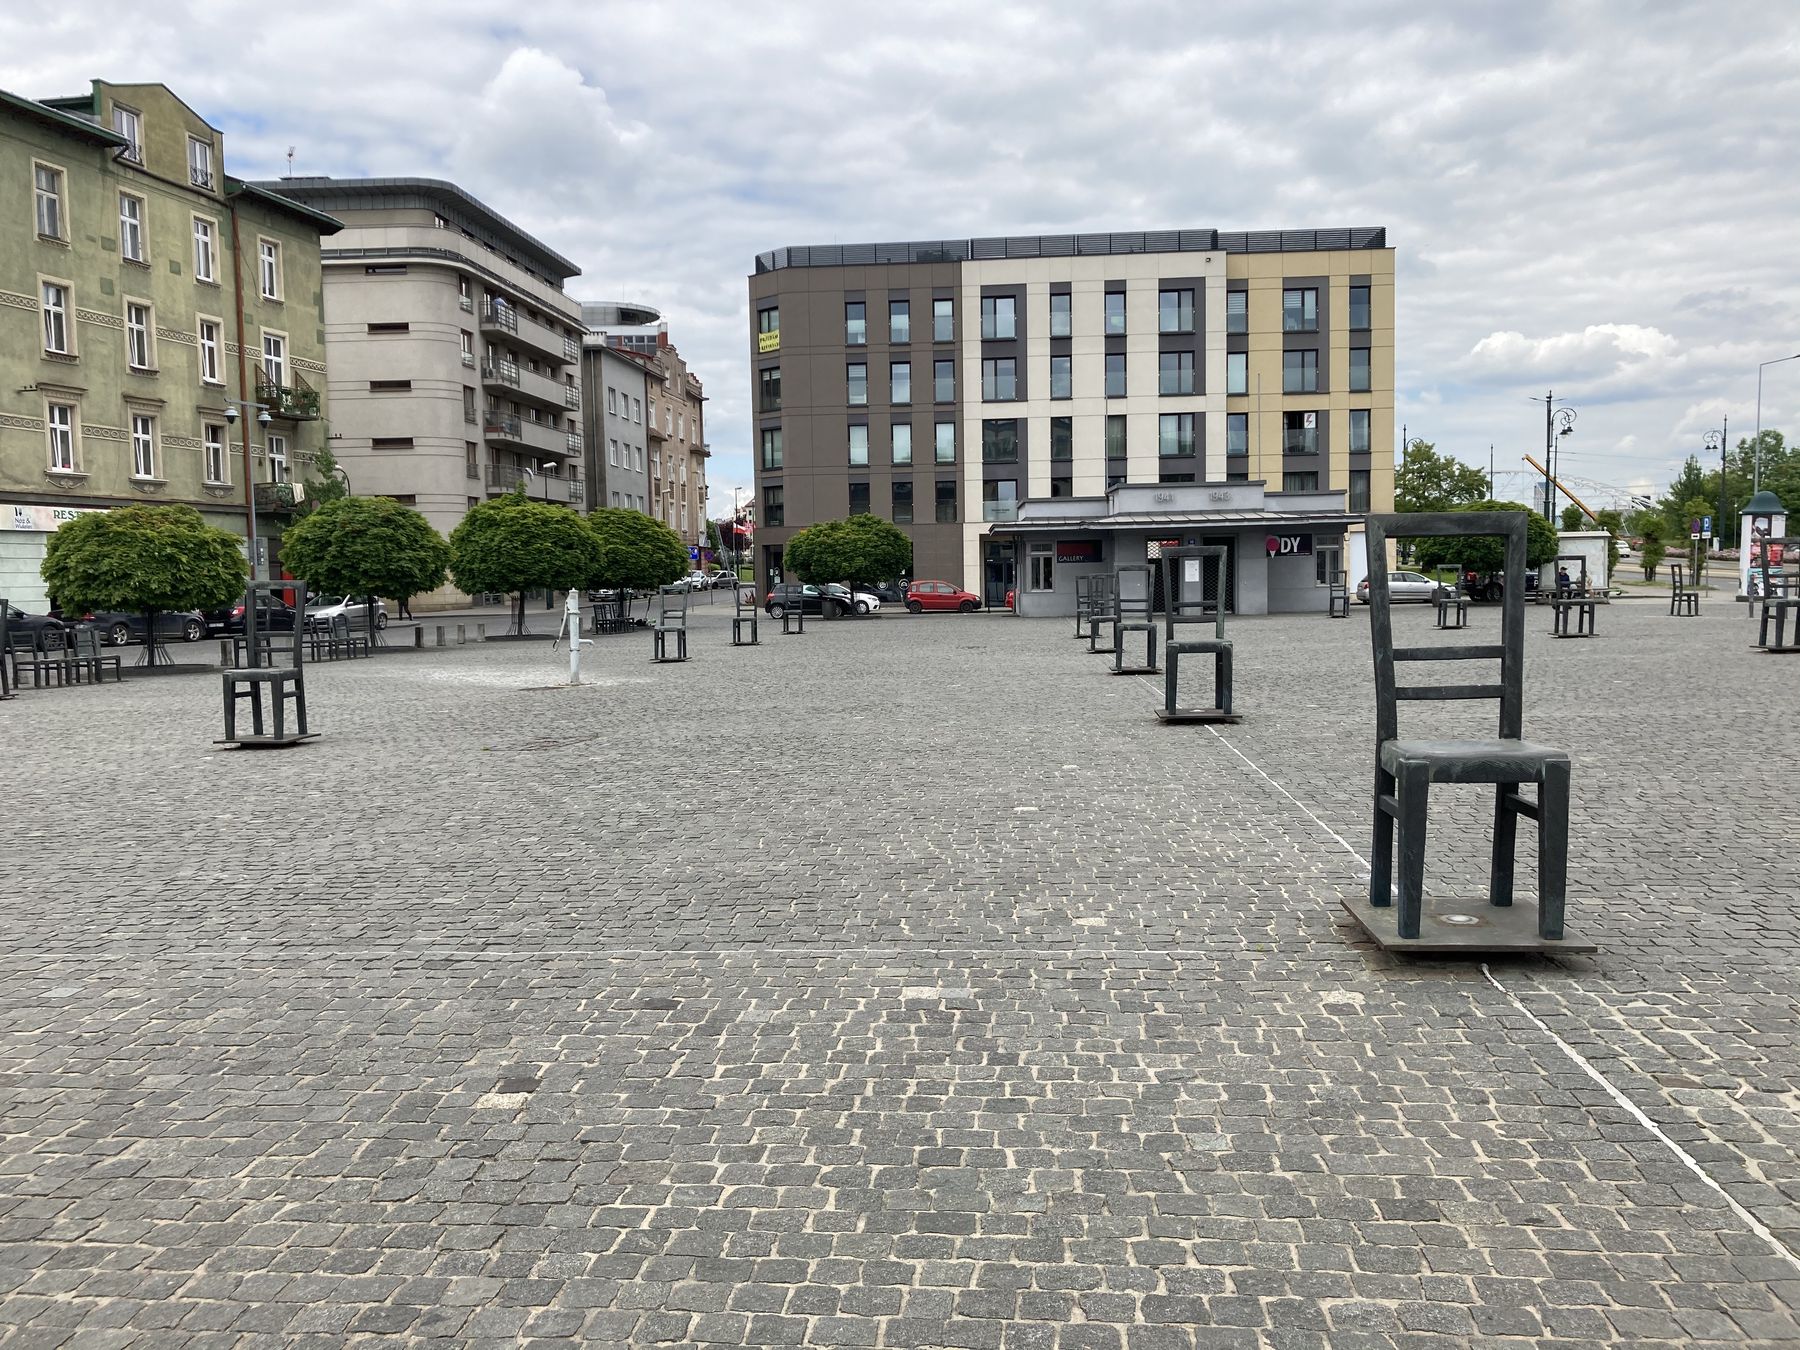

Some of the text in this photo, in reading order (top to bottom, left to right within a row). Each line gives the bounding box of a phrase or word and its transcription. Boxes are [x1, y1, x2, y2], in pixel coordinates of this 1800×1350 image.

[1154, 489, 1232, 503] 1941 1943
[53, 509, 82, 520] REST
